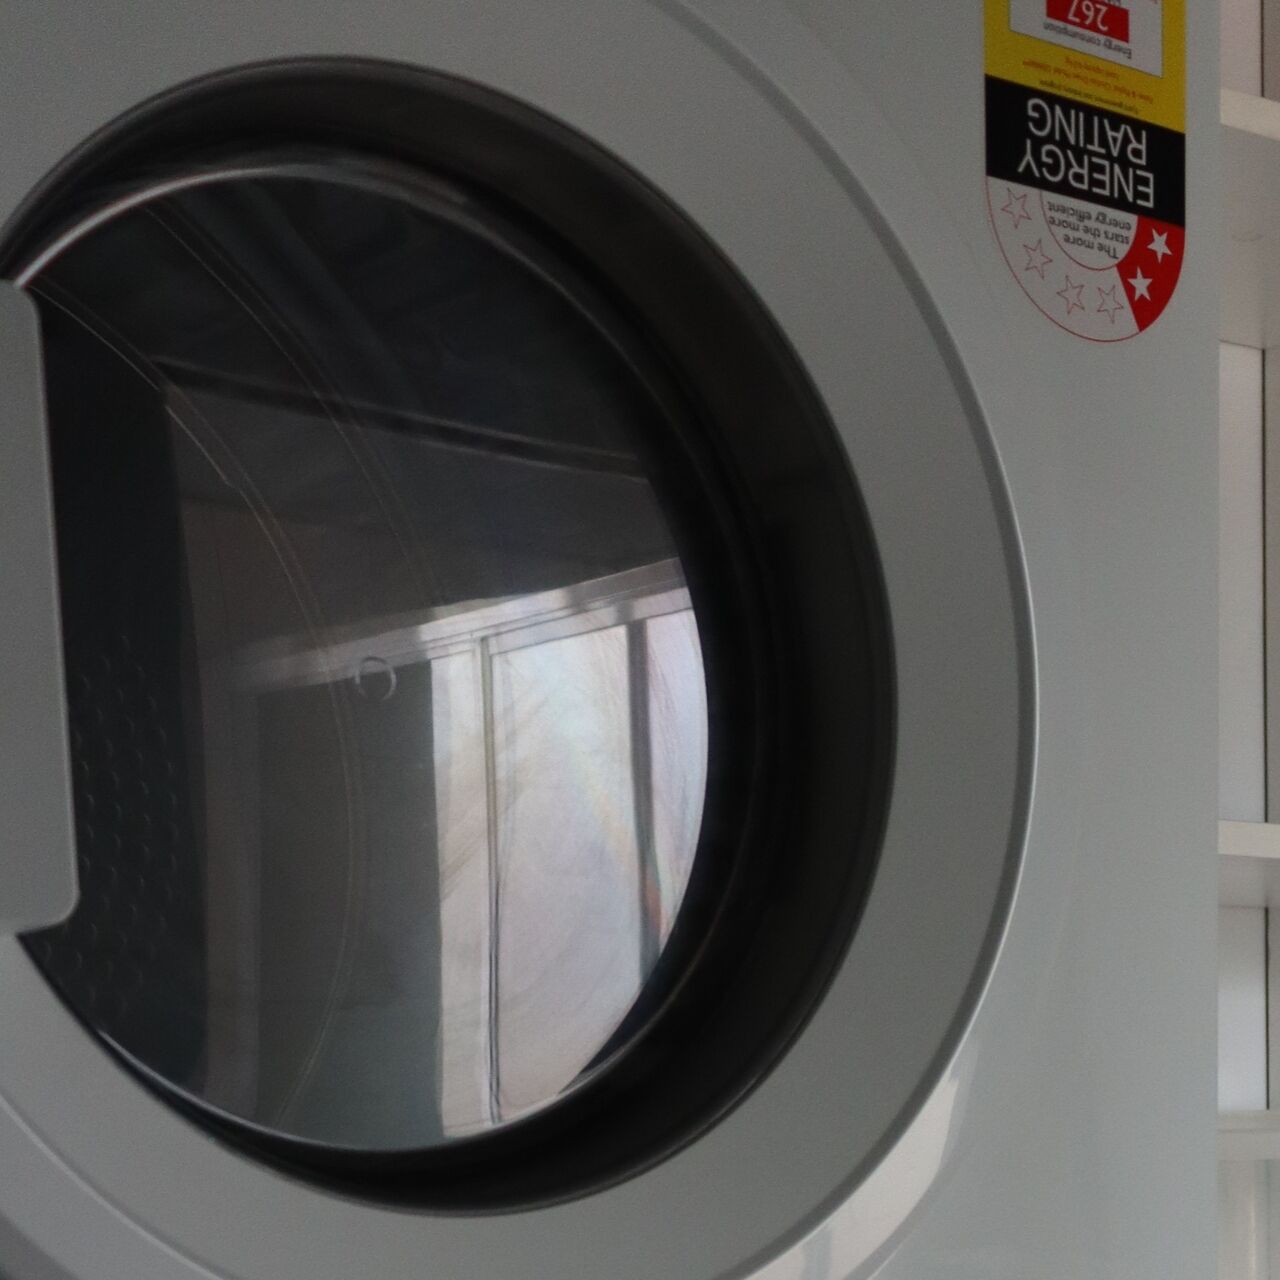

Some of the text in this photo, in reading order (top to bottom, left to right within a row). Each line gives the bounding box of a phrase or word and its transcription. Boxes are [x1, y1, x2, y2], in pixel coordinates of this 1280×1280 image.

[1067, 0, 1109, 31] 267
[1043, 23, 1132, 59] Energy consumption
[1027, 98, 1147, 165] RATING
[1017, 138, 1154, 207] ENERGY
[1048, 202, 1131, 230] energy efficient
[1048, 216, 1130, 245] stars the more
[1063, 234, 1119, 259] The more
